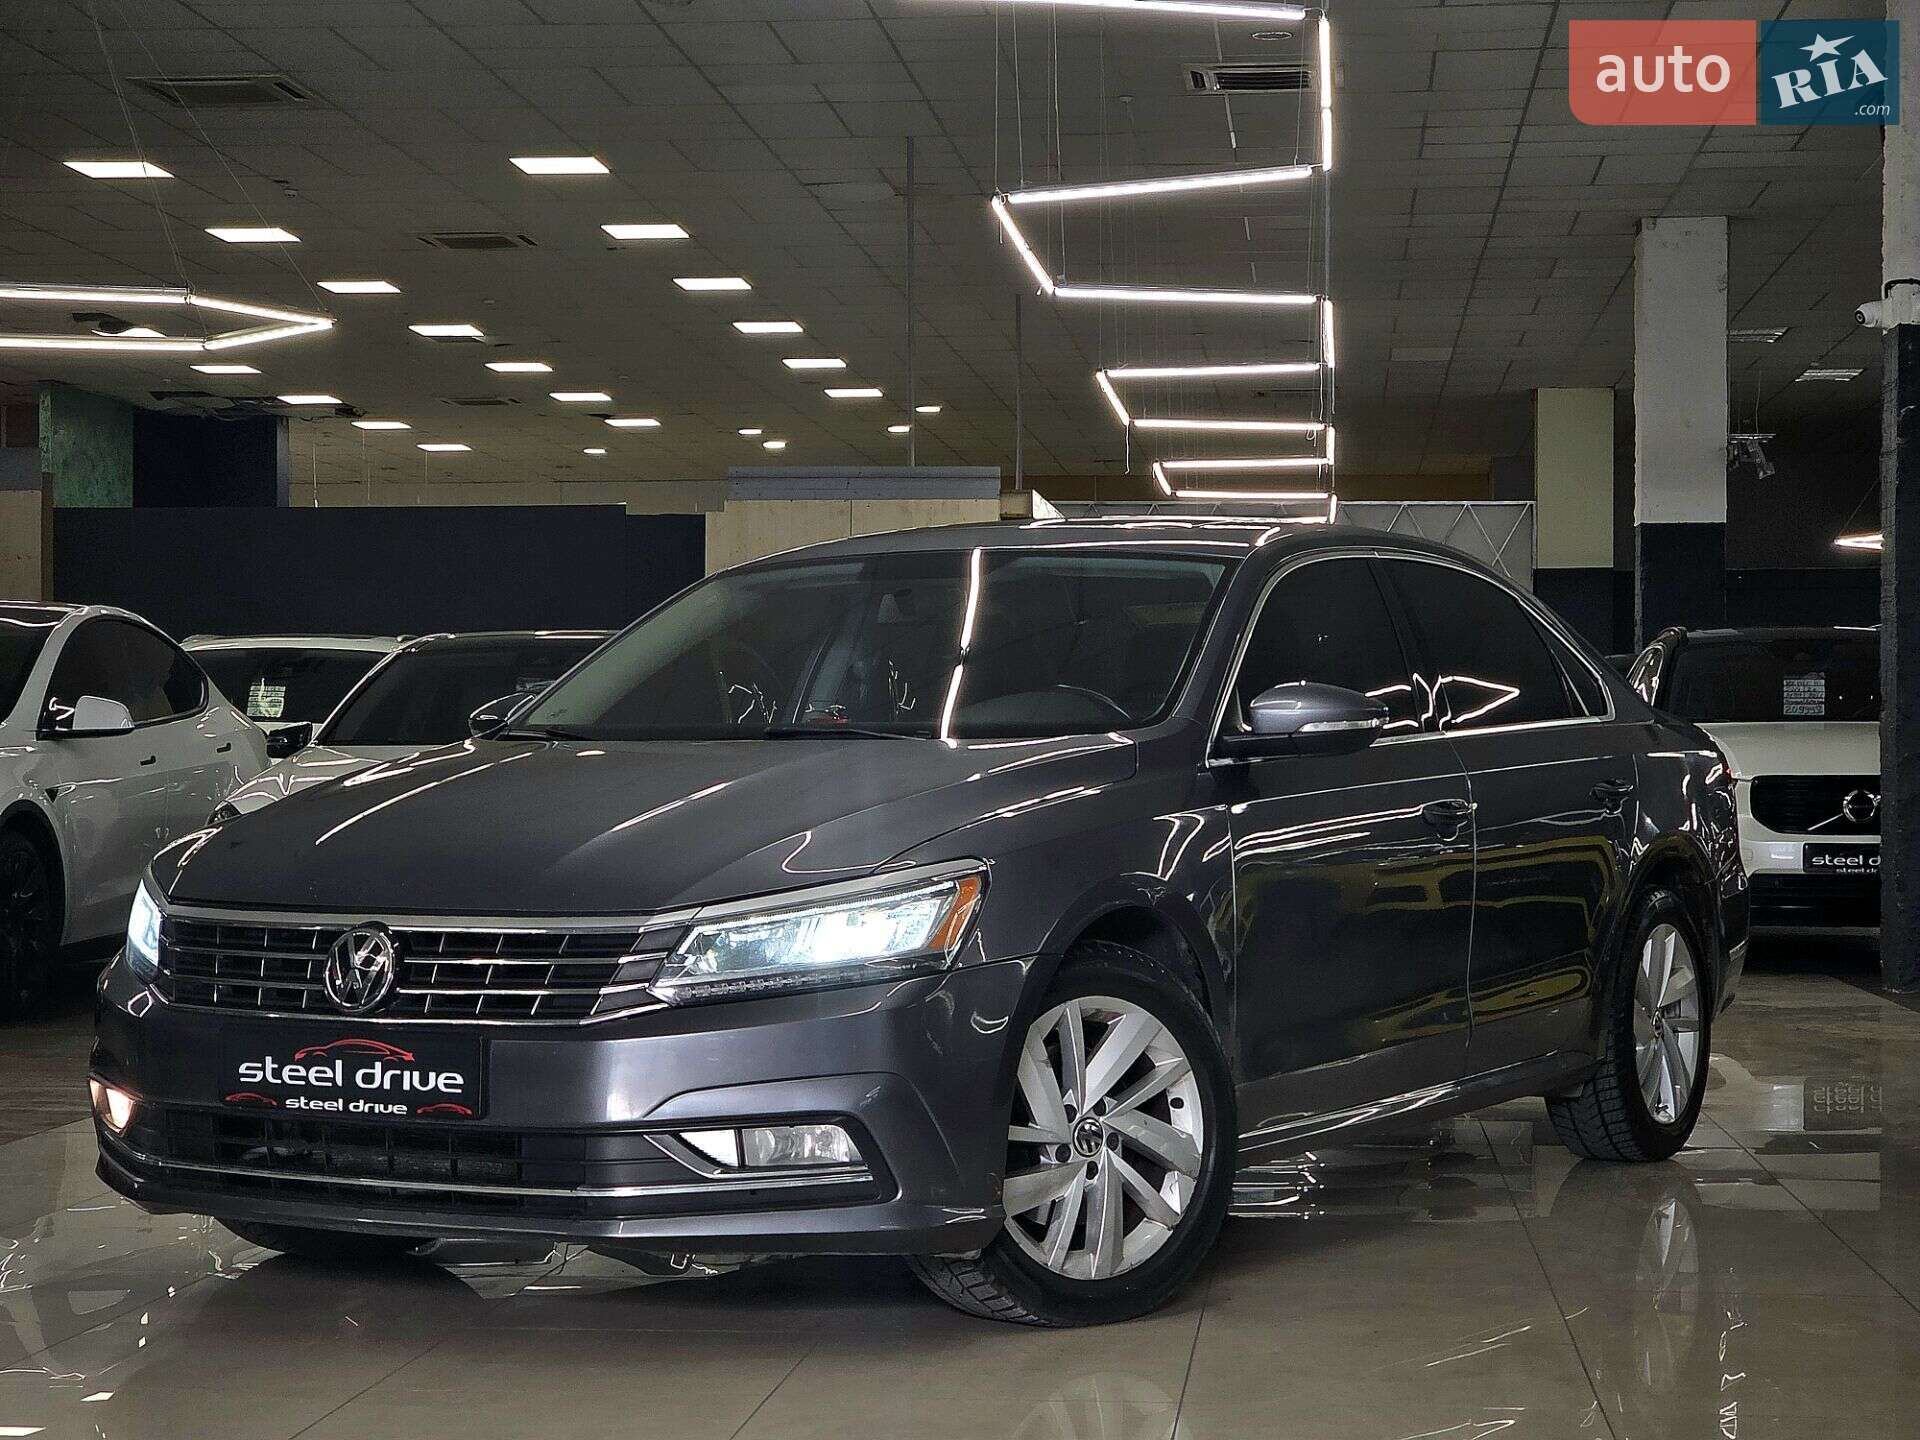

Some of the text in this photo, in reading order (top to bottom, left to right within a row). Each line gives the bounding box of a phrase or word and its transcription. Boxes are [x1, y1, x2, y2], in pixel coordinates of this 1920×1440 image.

[1811, 854, 1864, 866] steel
[238, 1056, 464, 1093] steel drive
[285, 1097, 408, 1115] steel drive
